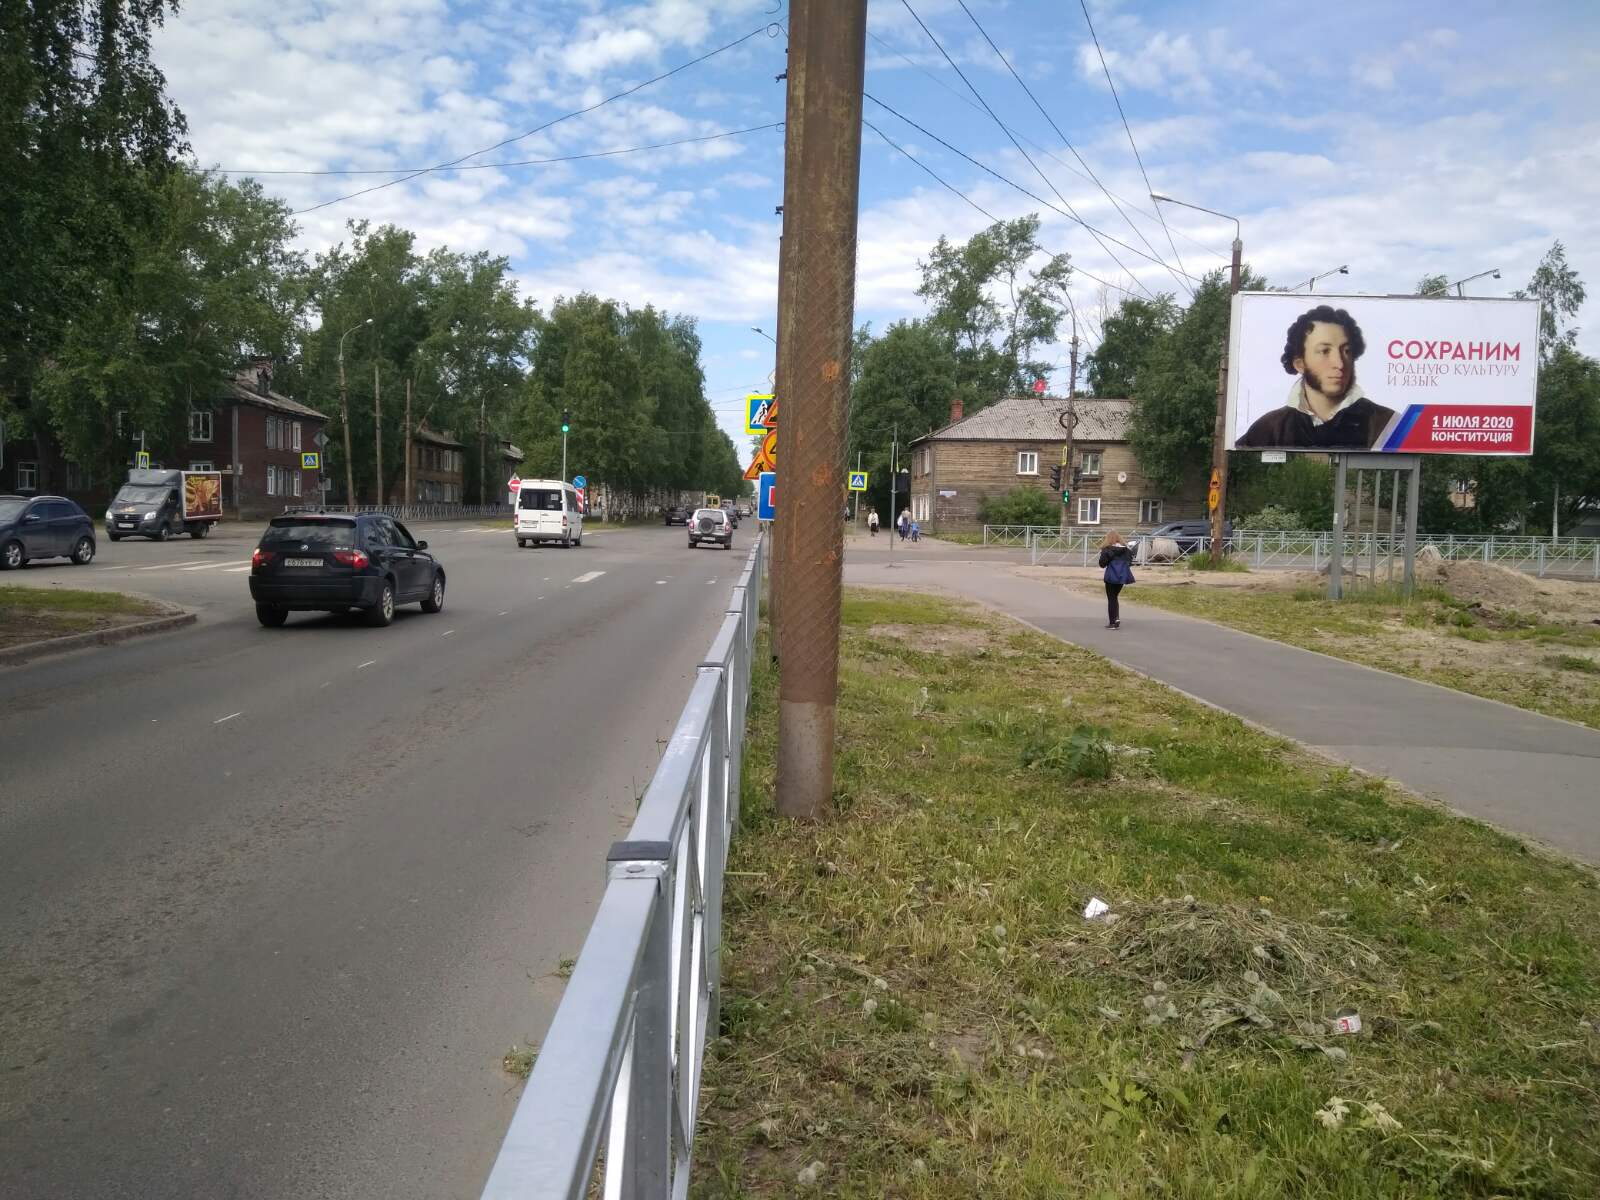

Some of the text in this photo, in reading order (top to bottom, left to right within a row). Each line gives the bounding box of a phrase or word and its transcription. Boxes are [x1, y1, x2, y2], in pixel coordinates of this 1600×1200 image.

[1387, 339, 1521, 361] СОХРАНИМ
[1387, 362, 1520, 376] РОДНУЮ КУЛЬТУРУ
[1387, 375, 1439, 387] И ЯЗЫК
[1432, 416, 1514, 429] 1 ИЮЛЯ 2020
[1431, 431, 1513, 443] КОНСТИТУЦИЯ
